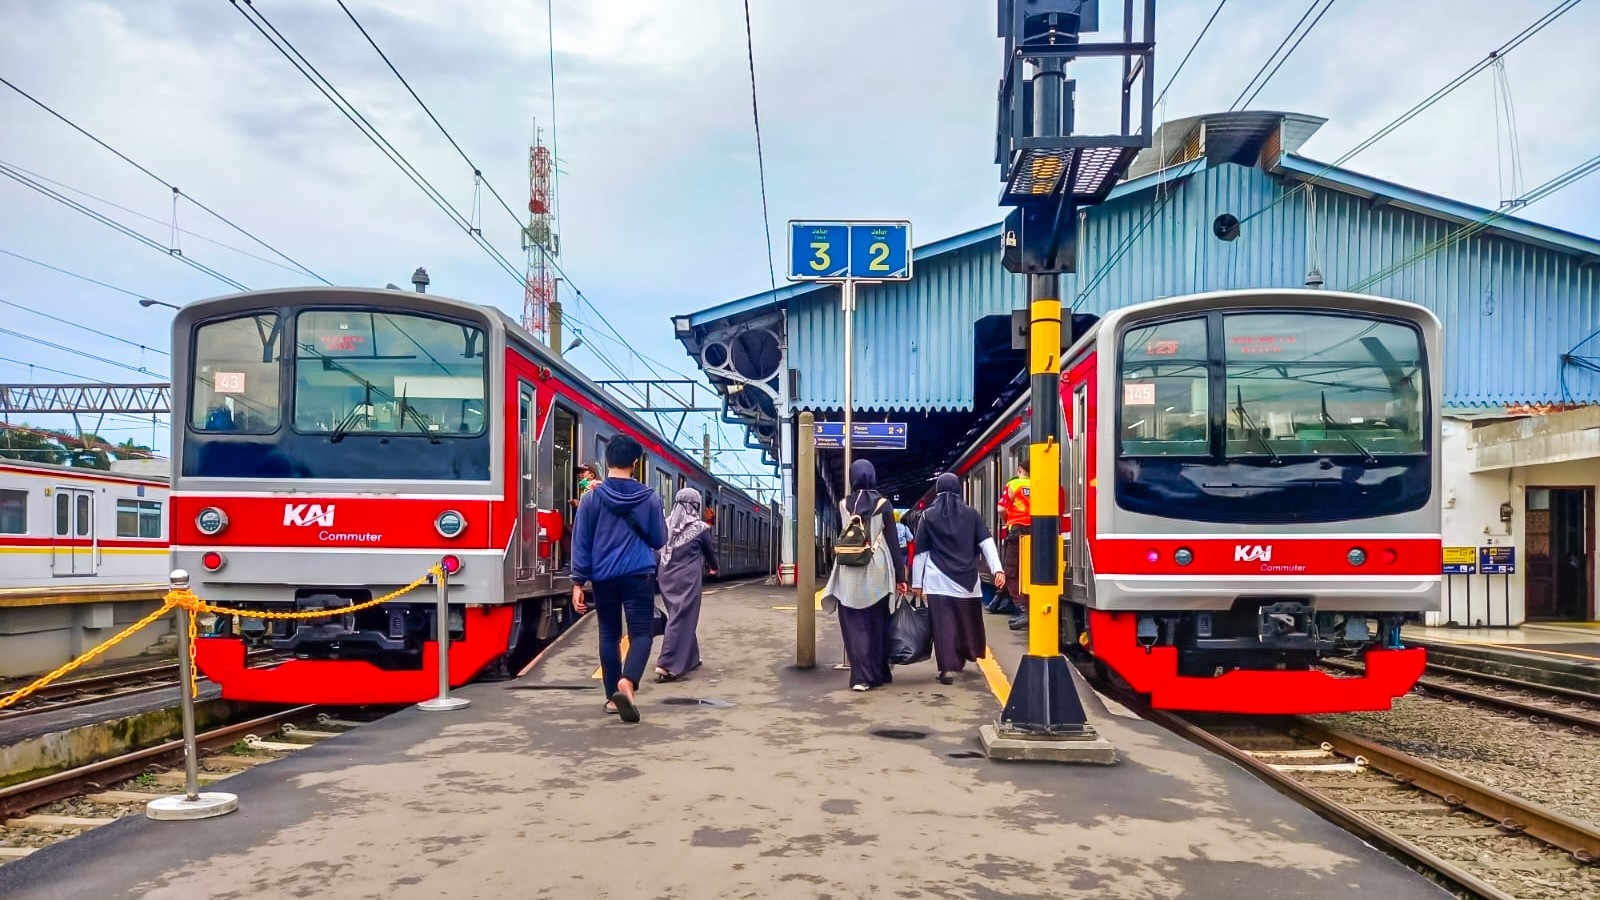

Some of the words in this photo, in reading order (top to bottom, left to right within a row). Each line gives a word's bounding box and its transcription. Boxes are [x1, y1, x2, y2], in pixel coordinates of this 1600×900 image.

[809, 242, 831, 271] 3
[868, 242, 890, 271] 2
[220, 375, 239, 389] 43
[1128, 388, 1151, 400] 145
[283, 503, 336, 527] KAI
[319, 530, 382, 543] Commuter
[1234, 544, 1273, 562] KAI
[1260, 563, 1307, 572] Commuter
